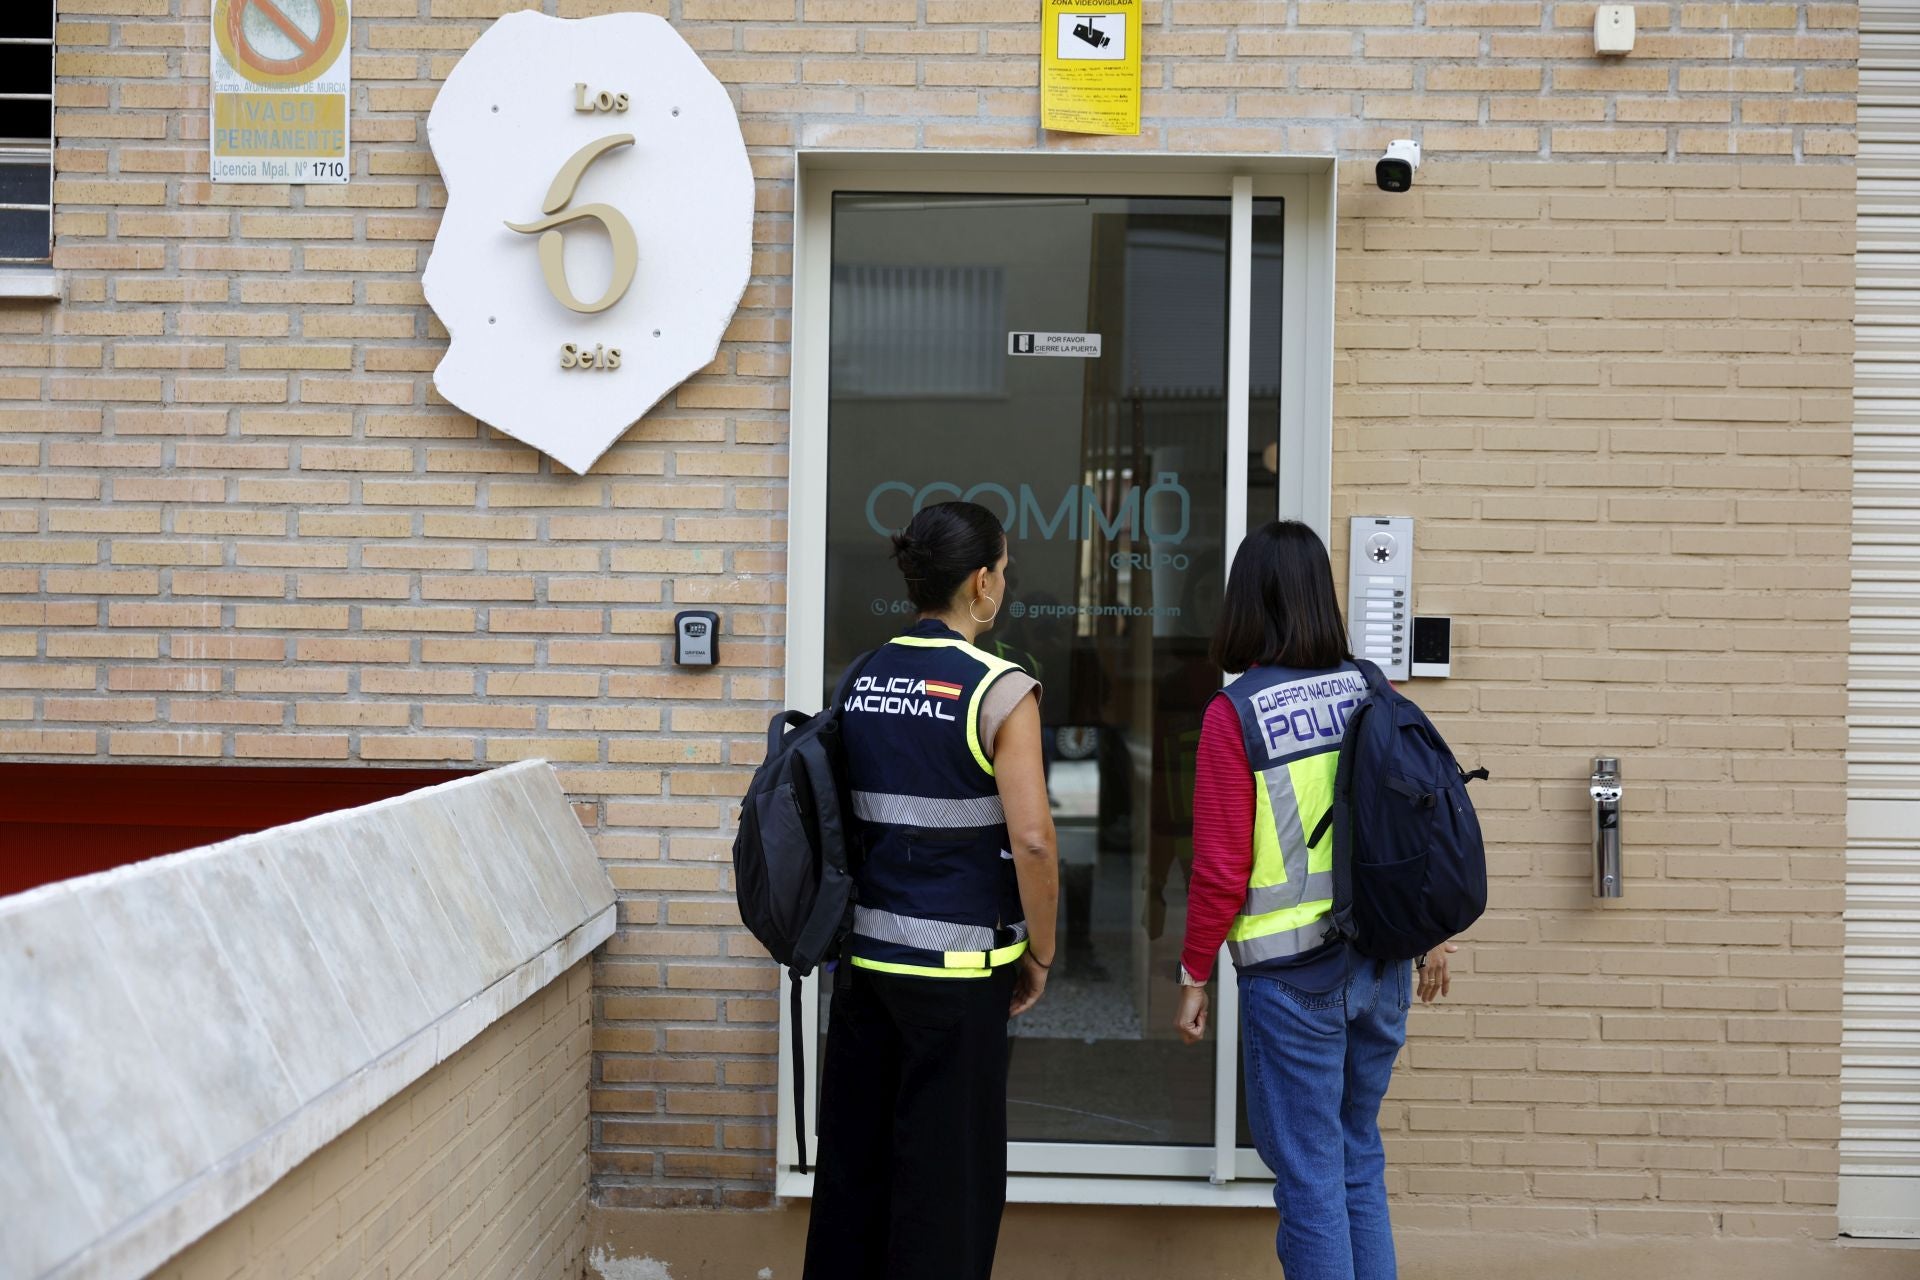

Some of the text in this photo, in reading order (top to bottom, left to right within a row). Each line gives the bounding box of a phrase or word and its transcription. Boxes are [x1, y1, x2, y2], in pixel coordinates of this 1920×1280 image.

[303, 82, 314, 92] DE
[317, 82, 346, 93] MURCIA
[574, 83, 629, 113] Los
[246, 101, 316, 122] VADO
[216, 129, 343, 150] PERMANENTE
[213, 160, 257, 177] Licencia
[262, 161, 290, 179] Mpal.
[313, 162, 344, 177] 1710
[560, 343, 622, 370] Seis
[1110, 553, 1189, 571] GRUPO
[1257, 688, 1307, 713] CUERPO
[1308, 676, 1362, 699] NACIONAL
